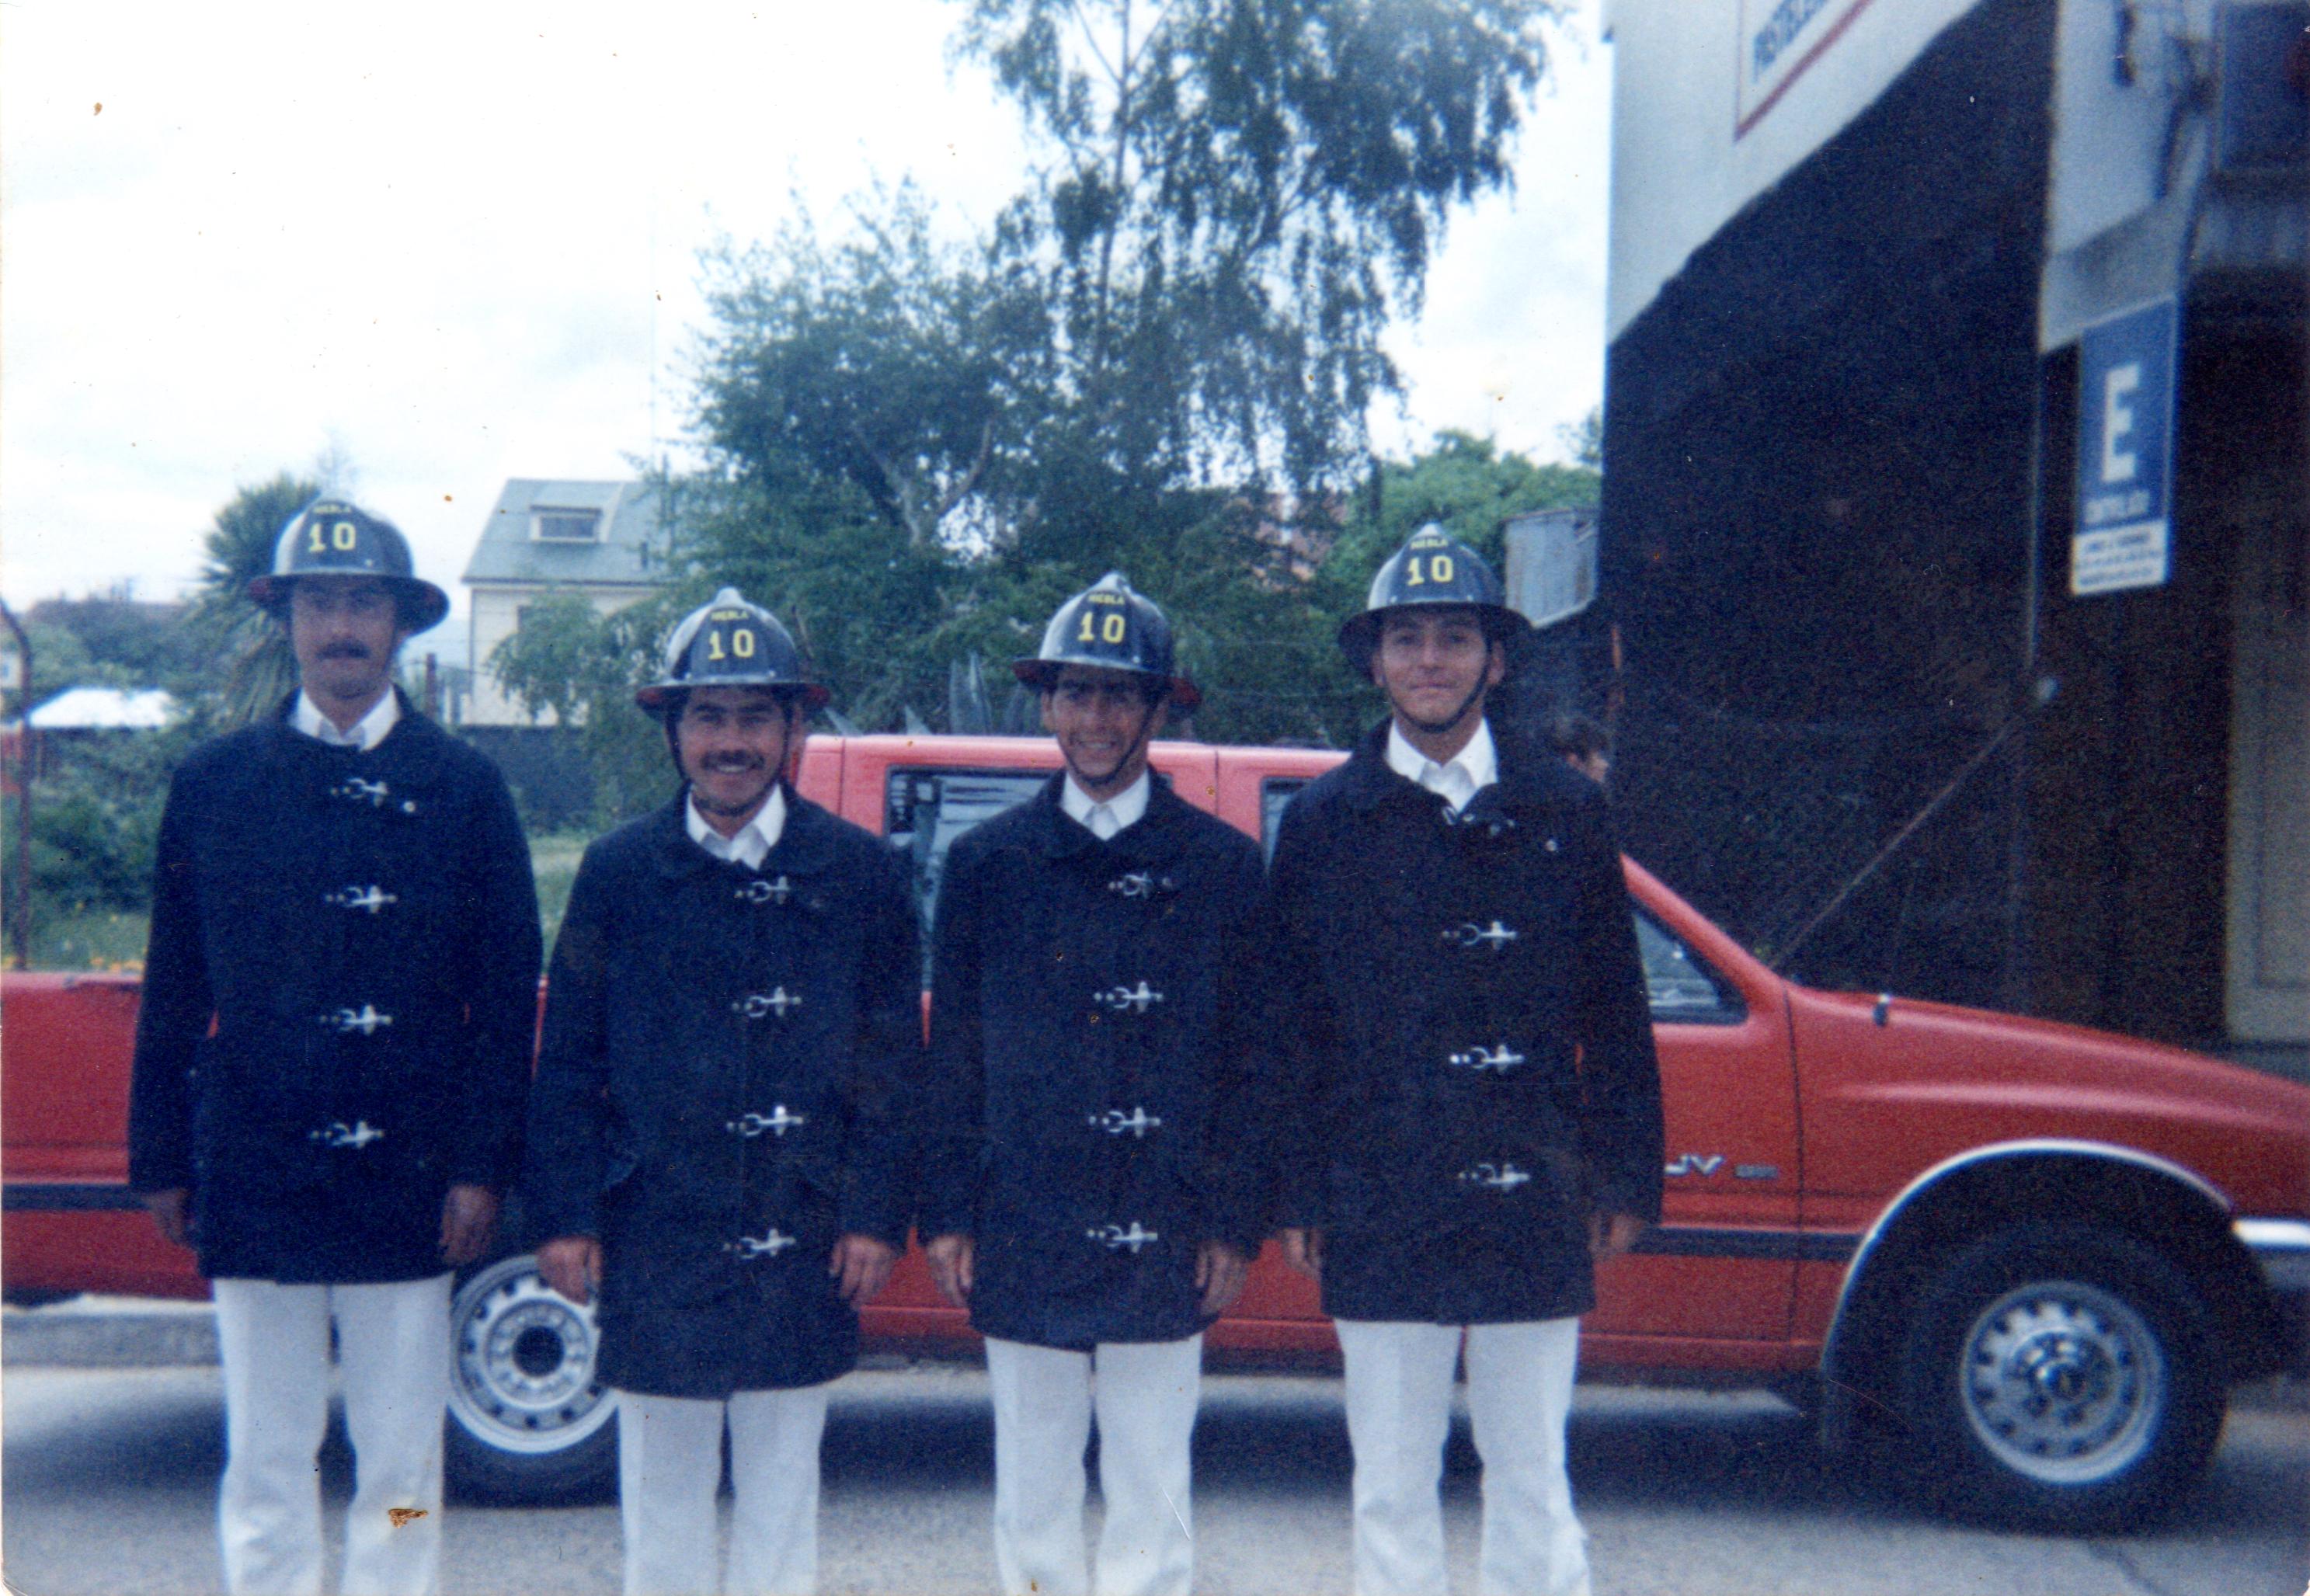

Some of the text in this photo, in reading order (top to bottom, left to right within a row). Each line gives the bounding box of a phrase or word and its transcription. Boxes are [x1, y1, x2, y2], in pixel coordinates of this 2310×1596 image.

[2102, 364, 2139, 483] E
[308, 522, 357, 552] 10
[1407, 555, 1454, 586] 10
[1077, 611, 1125, 644] 10
[708, 629, 754, 661] 10
